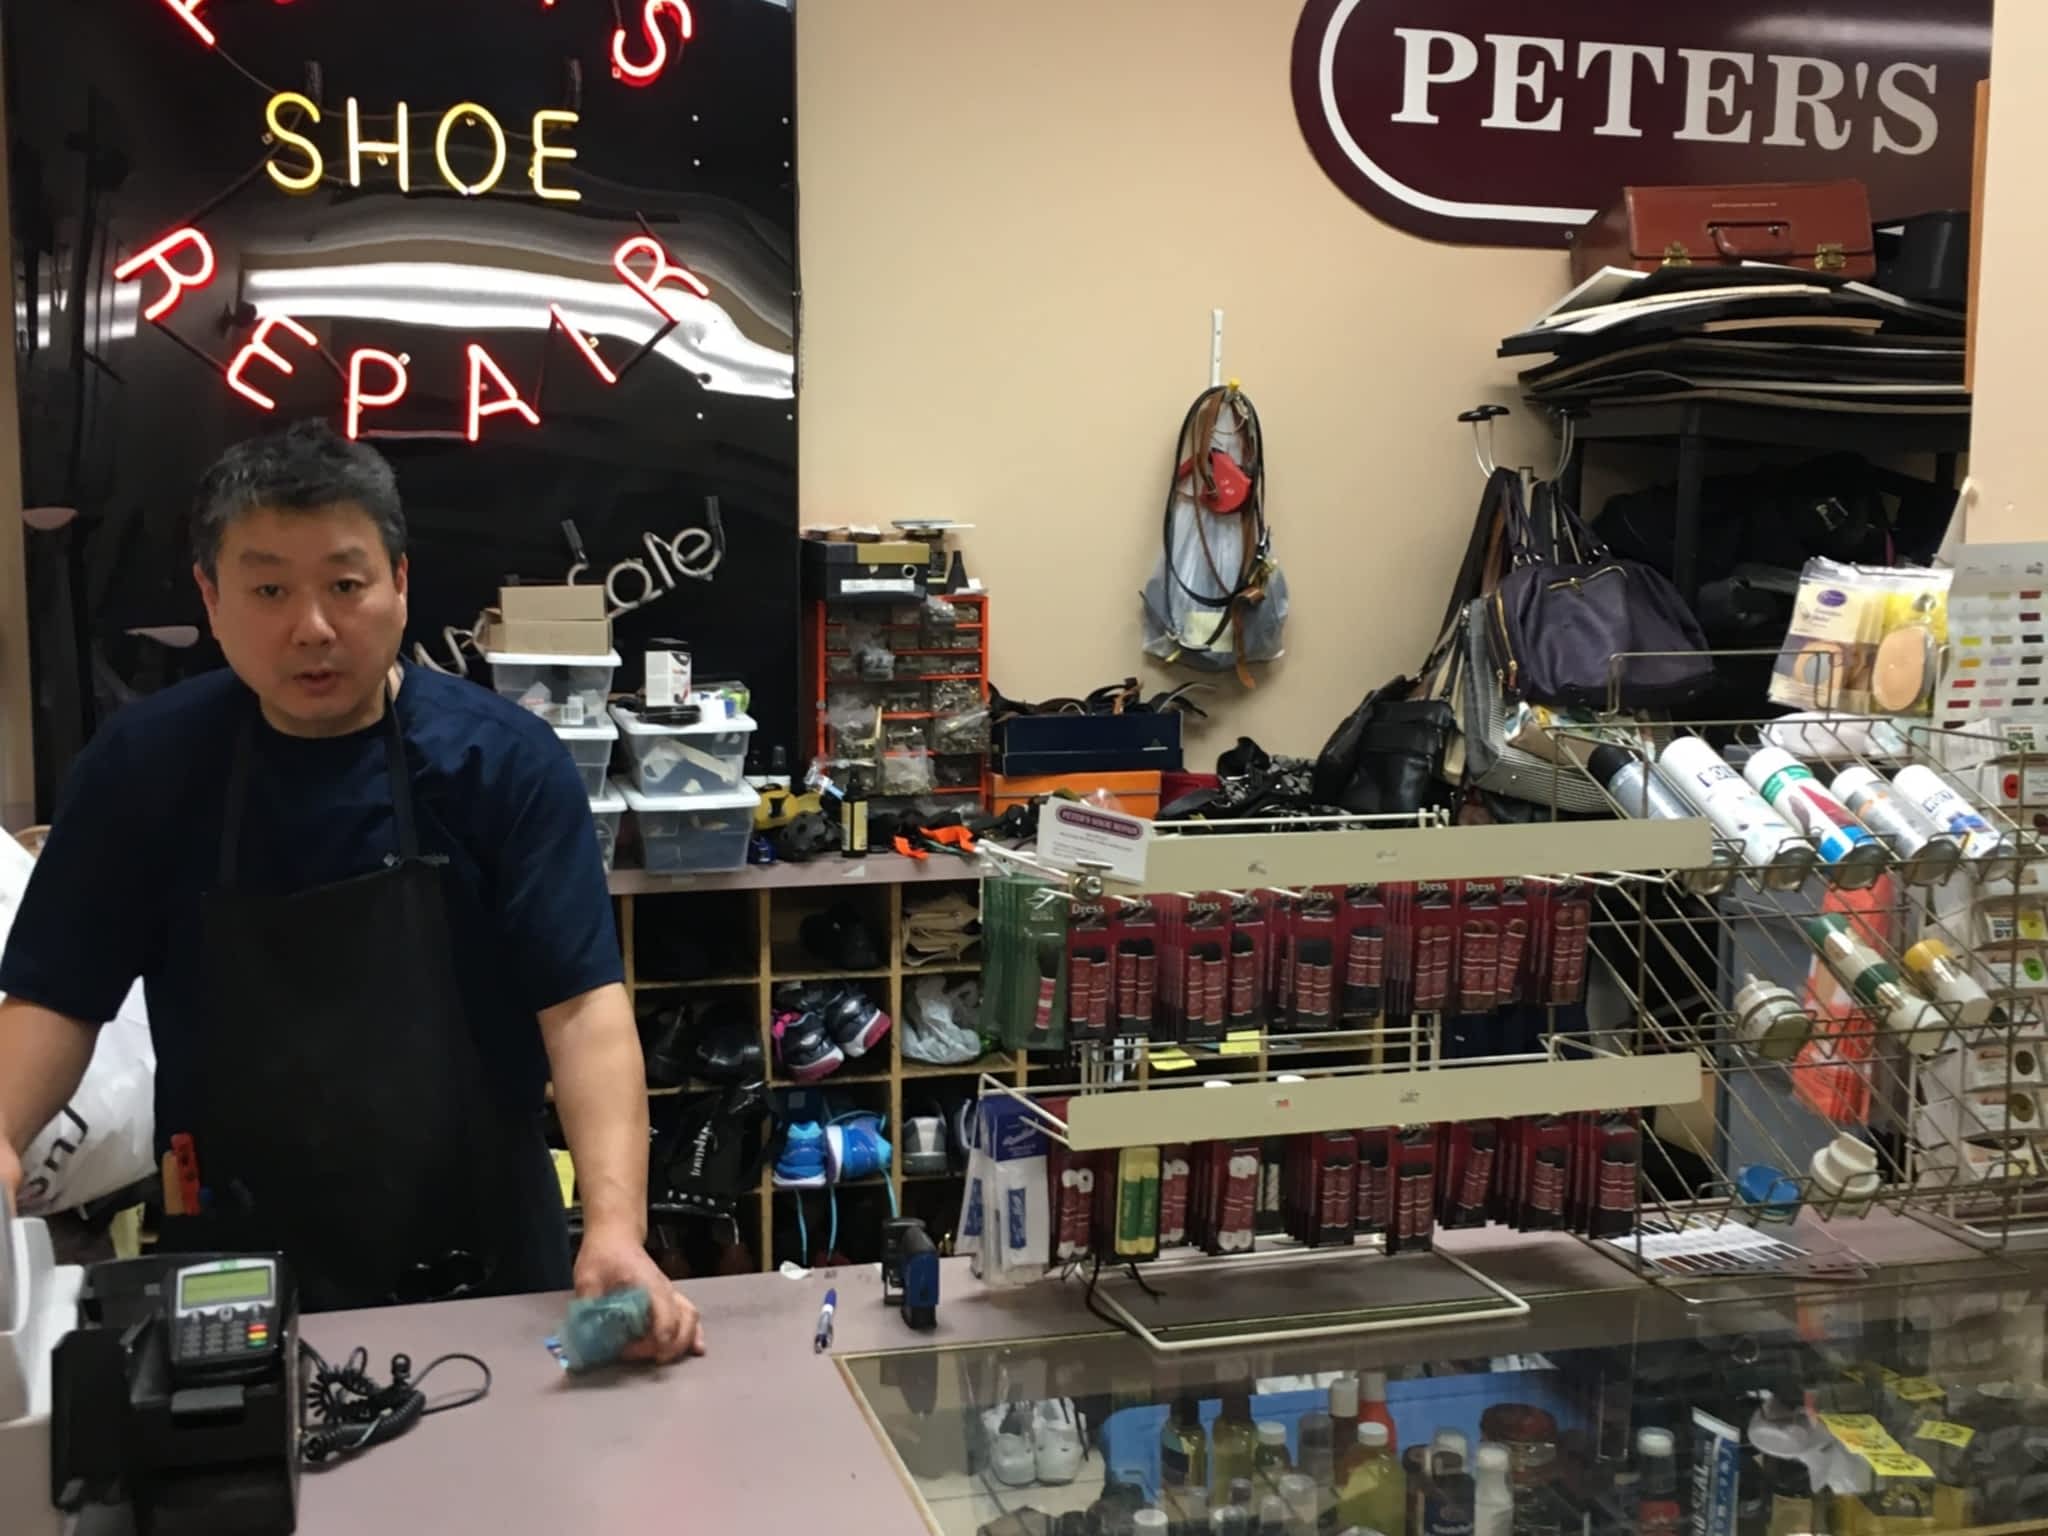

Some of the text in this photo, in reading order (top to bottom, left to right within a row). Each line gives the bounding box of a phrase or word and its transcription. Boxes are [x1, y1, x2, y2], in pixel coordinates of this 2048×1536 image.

[1390, 27, 1940, 156] PETER'S
[265, 92, 582, 200] SHOE
[113, 226, 710, 442] REPAIR
[1418, 880, 1449, 893] Dress
[1465, 881, 1496, 894] Dress
[1071, 902, 1105, 915] Dress
[1188, 900, 1221, 914] Dress
